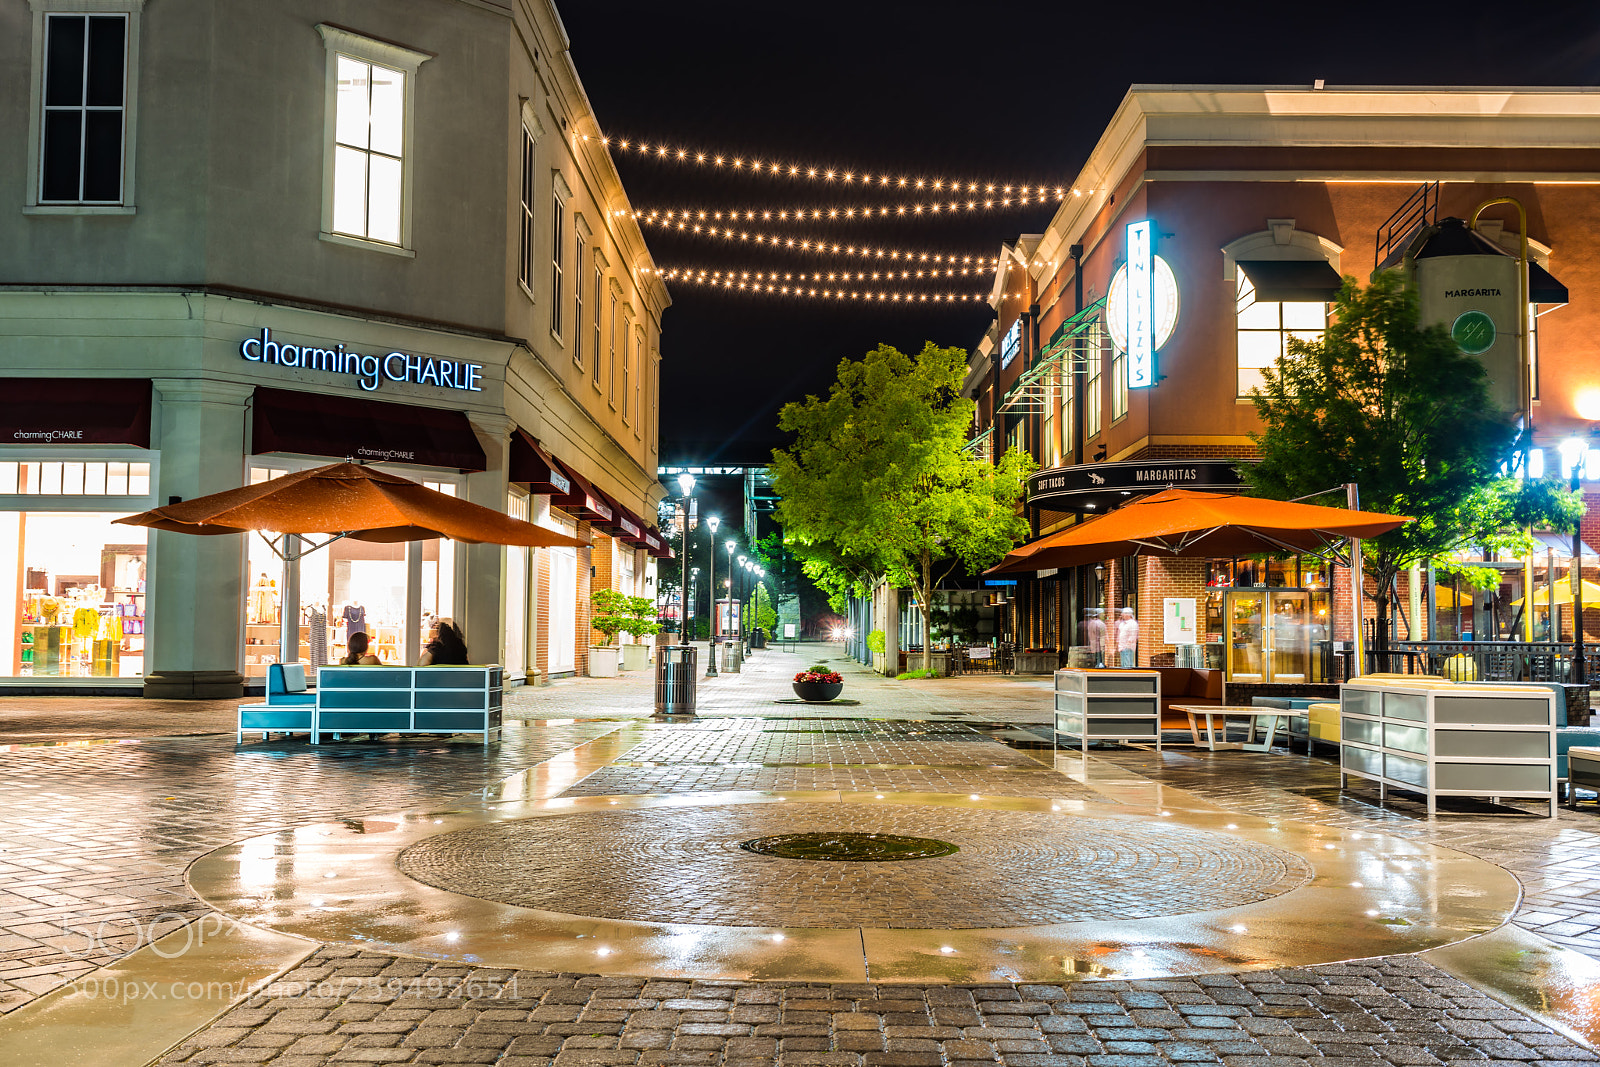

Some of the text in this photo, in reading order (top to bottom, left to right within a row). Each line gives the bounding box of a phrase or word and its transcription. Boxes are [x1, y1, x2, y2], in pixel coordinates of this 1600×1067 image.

[1444, 288, 1502, 298] MARGARITA
[1134, 229, 1145, 382] TIN LIZZYS
[1136, 468, 1197, 482] MARGARITAS
[1038, 476, 1065, 491] SOFT TACOS
